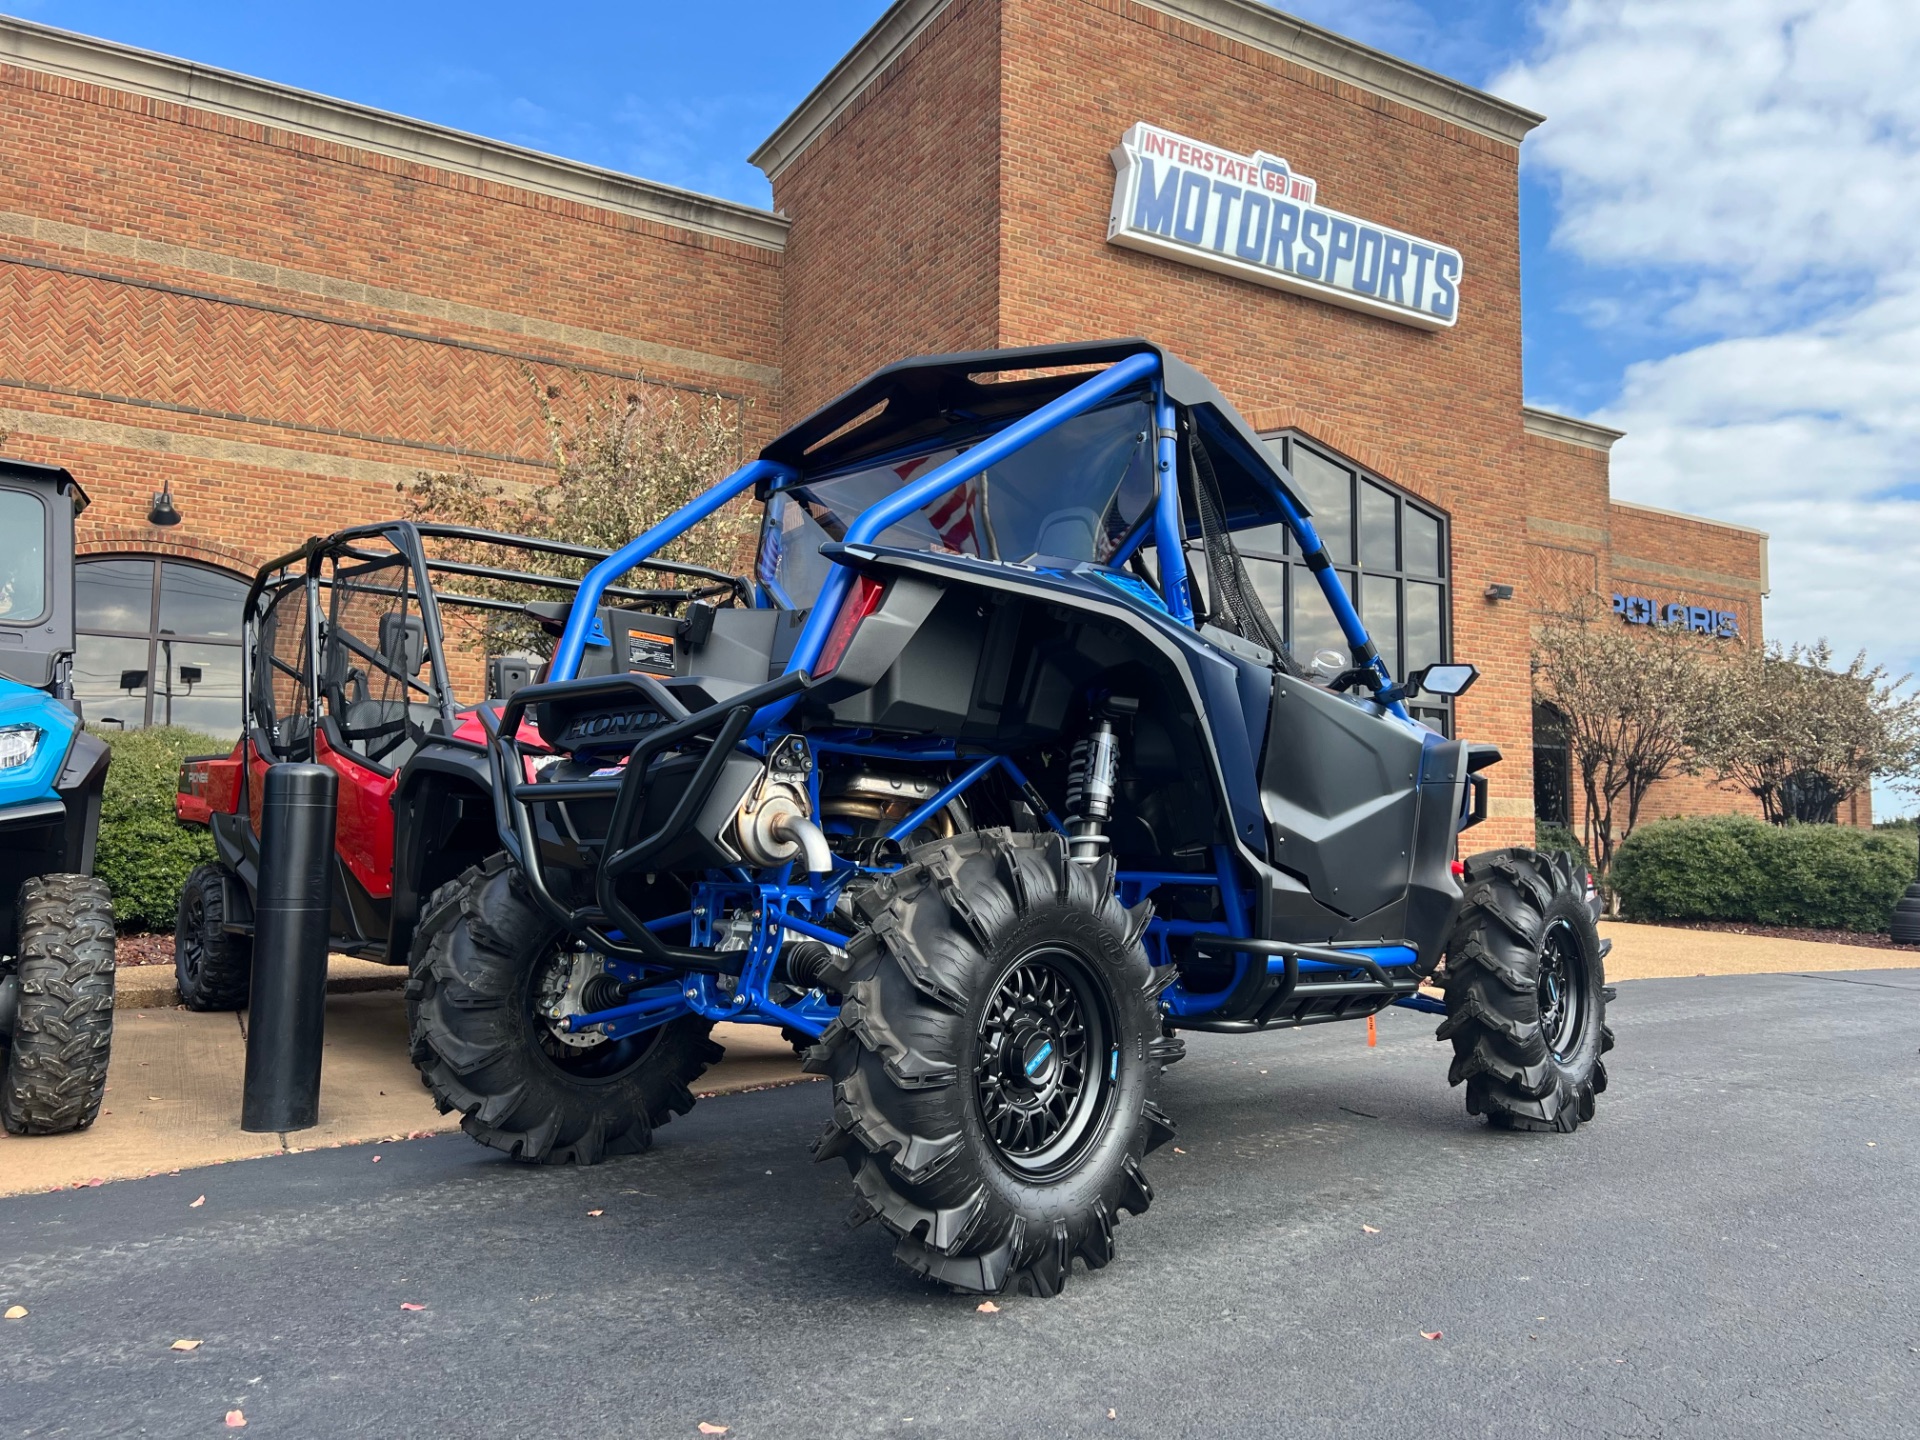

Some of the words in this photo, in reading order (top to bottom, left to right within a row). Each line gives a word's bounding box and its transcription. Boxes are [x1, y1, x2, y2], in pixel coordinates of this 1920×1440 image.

[1144, 132, 1259, 186] INTERSTATE
[1265, 172, 1288, 195] 69
[1133, 156, 1459, 317] MOTORSPORTS
[1612, 593, 1738, 637] POLARIS
